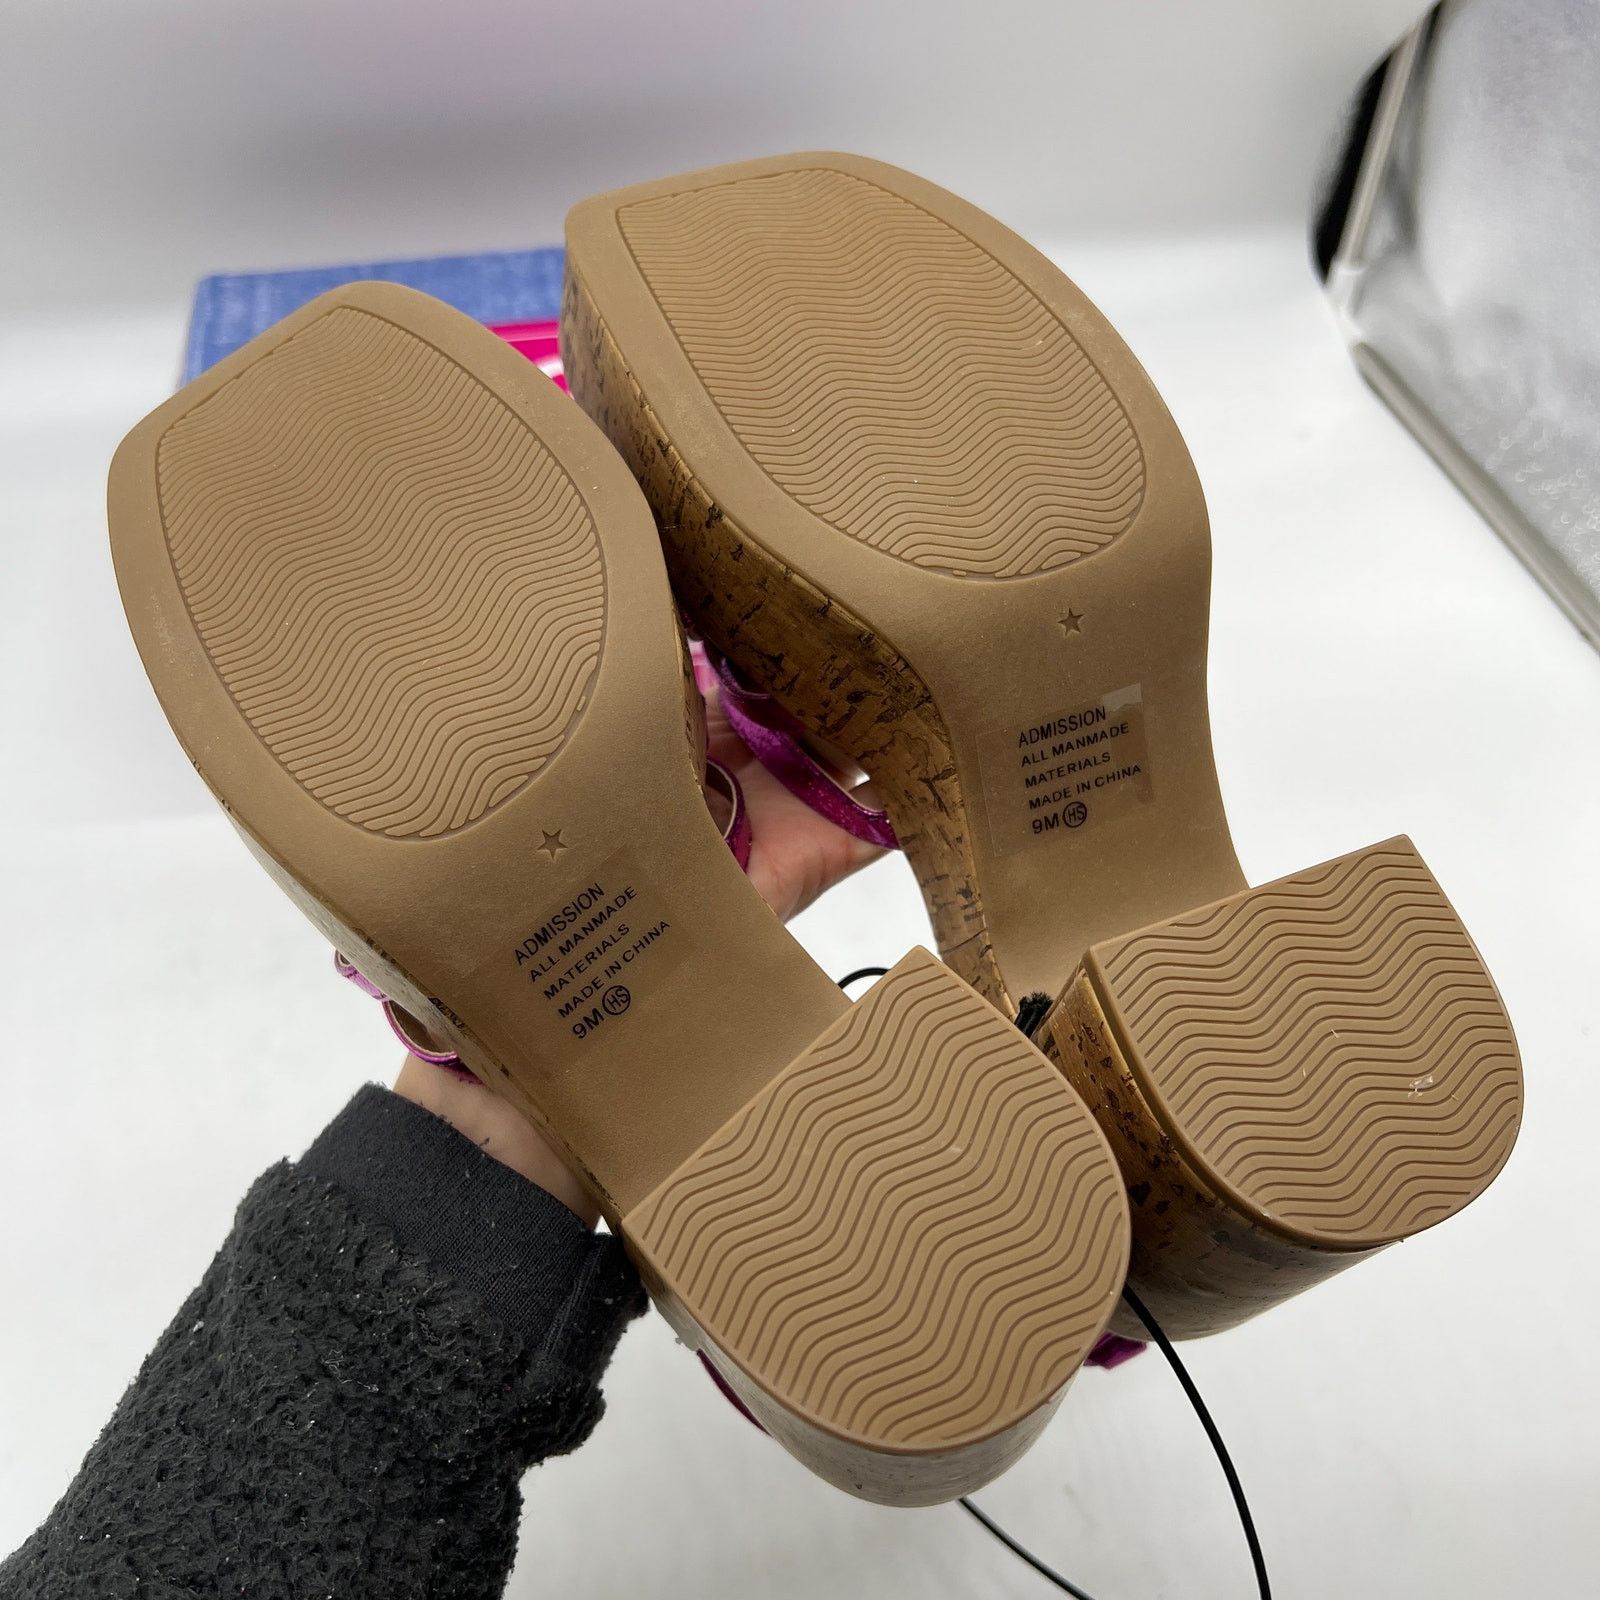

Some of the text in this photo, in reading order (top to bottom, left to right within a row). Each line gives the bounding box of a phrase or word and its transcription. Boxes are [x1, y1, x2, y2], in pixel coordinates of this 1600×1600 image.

[1018, 706, 1106, 748] ADMISSION
[1021, 722, 1129, 768] ALL MANMADE
[1025, 752, 1111, 788] MATERIALS
[1029, 765, 1142, 810] MADE IN CHINA
[1032, 804, 1087, 834] 9M HS
[515, 883, 605, 965] ADMISSION
[530, 886, 637, 982] ALL MANMADE
[543, 923, 630, 1000] MATERIALS
[557, 920, 670, 1018] MADE IN CHINA
[572, 987, 630, 1039] 9M HS
